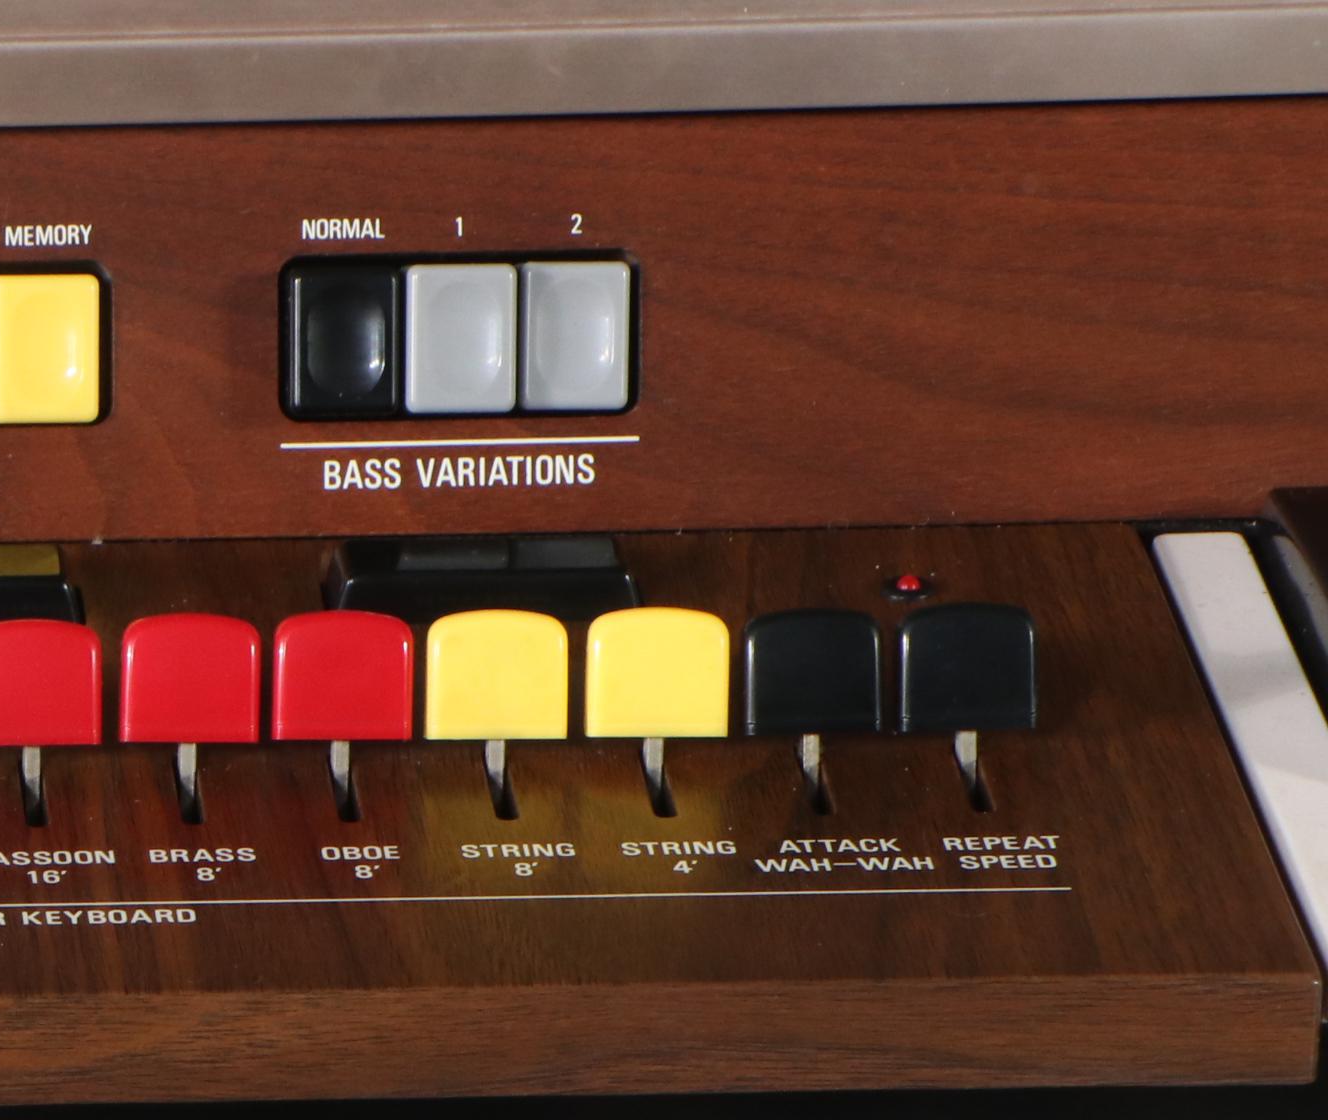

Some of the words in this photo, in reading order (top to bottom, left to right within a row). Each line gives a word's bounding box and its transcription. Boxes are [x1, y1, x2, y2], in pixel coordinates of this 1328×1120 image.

[302, 218, 385, 240] NORMAL
[455, 217, 463, 237] 1
[571, 214, 582, 235] 2
[4, 224, 92, 247] MEMORY
[323, 459, 401, 490] BASS
[416, 453, 596, 488] VARIATIONS
[461, 843, 576, 858] STRING
[621, 841, 736, 857] STRING
[780, 838, 901, 854] ATTACK
[943, 835, 1060, 852] REPEAT
[149, 848, 256, 864] BRASS
[321, 845, 400, 861] OBOE
[959, 854, 1057, 870] SPEED
[22, 909, 197, 925] KEYBOARD
